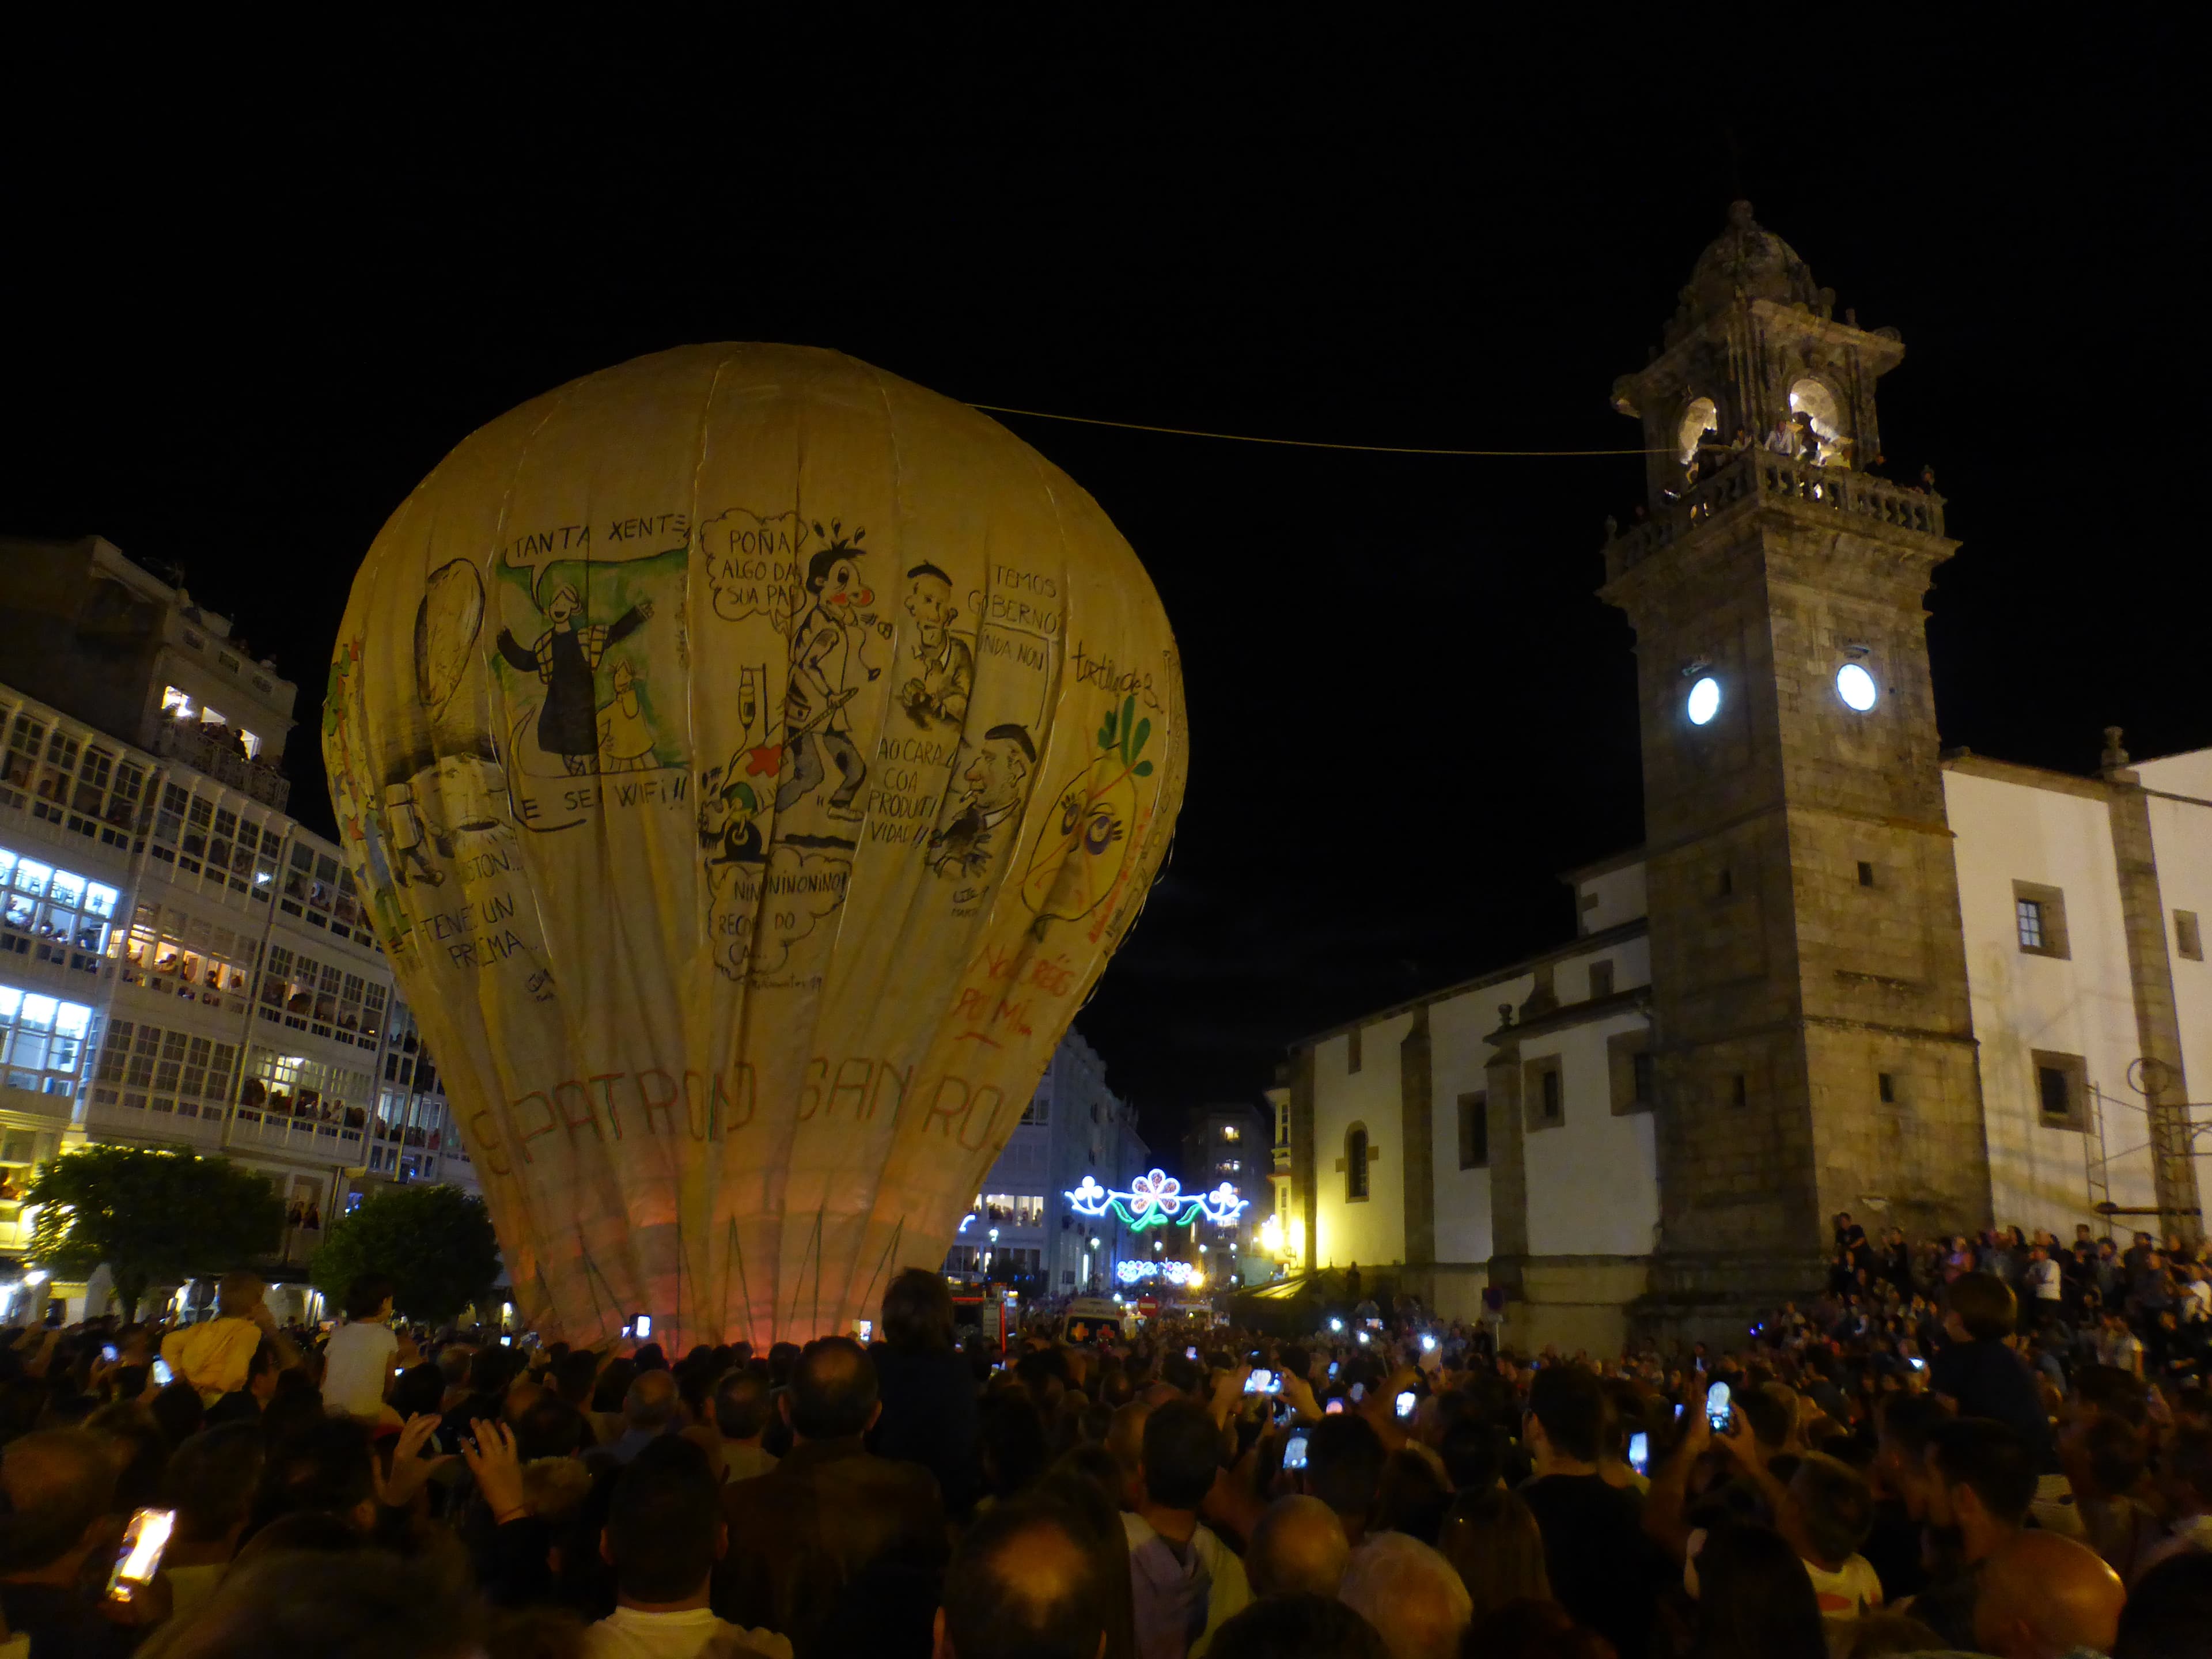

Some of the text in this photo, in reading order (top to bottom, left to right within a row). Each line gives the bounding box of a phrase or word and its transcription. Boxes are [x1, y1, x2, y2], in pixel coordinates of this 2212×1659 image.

[514, 525, 589, 558] TANTA
[729, 528, 790, 555] POÑA
[722, 558, 767, 581] ALGO
[994, 564, 1056, 599] TEMOS
[727, 586, 759, 605] SUA
[877, 738, 900, 761] AO
[521, 798, 541, 820] E
[482, 892, 514, 923] UN
